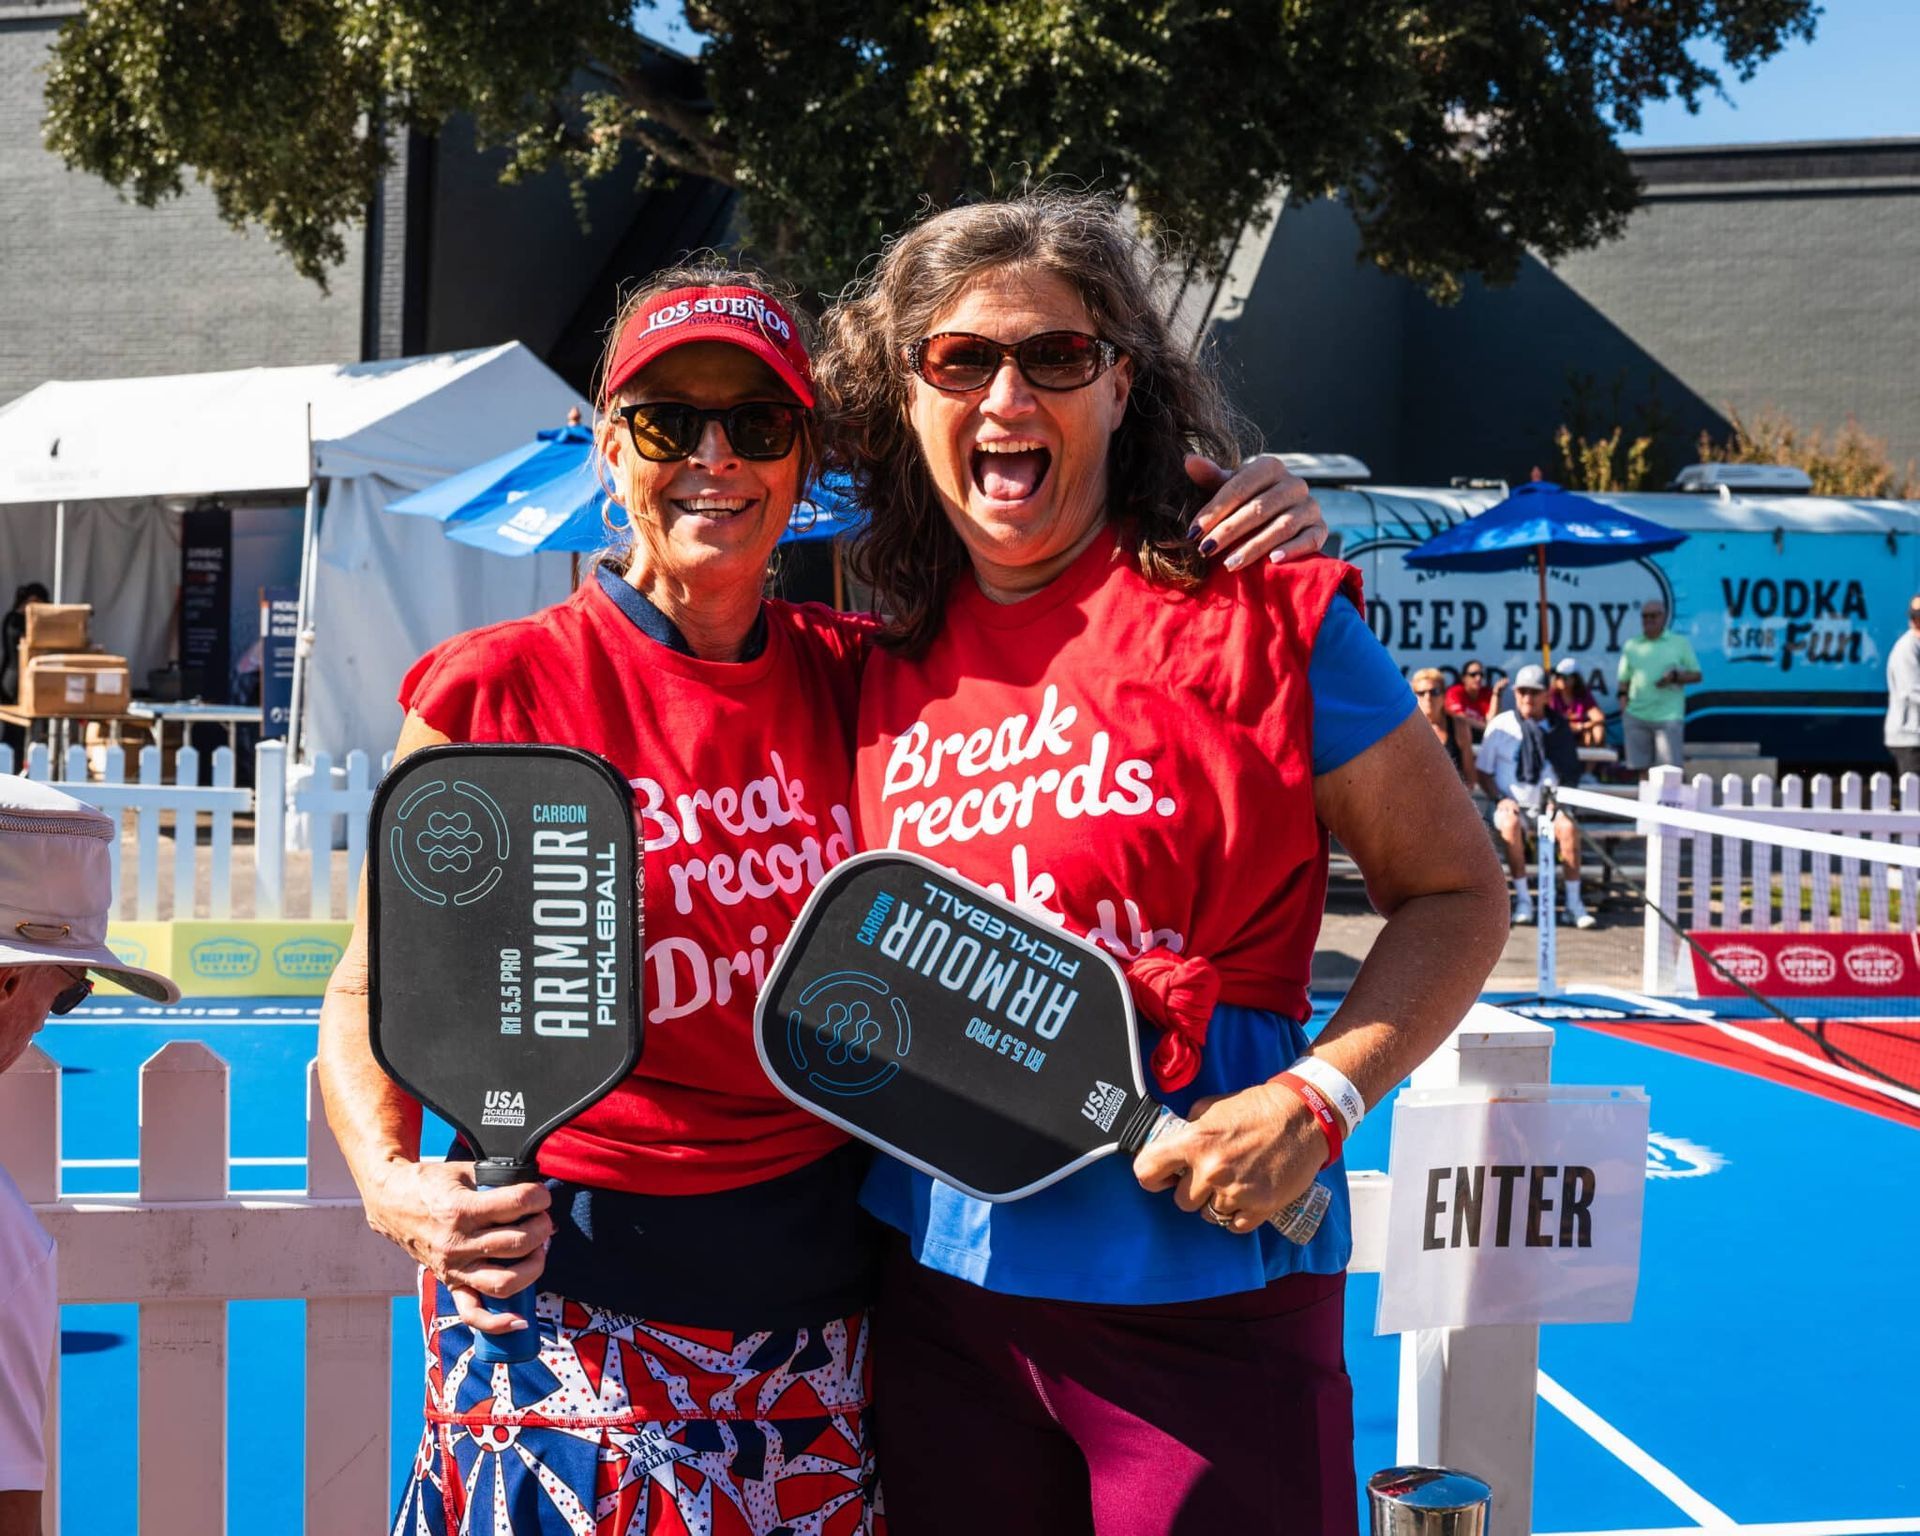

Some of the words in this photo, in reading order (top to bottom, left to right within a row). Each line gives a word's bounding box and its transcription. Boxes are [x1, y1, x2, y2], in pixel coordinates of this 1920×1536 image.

[641, 300, 692, 333] LOS
[694, 295, 791, 341] SUEÑOS
[1721, 576, 1868, 621] VODKA
[1366, 600, 1488, 651] DEEP
[1503, 600, 1630, 653] EDDY
[1727, 628, 1742, 648] IS
[1745, 628, 1777, 648] FOR
[1781, 622, 1863, 672] Fun
[882, 684, 1078, 802] Break
[628, 750, 816, 852] Break
[887, 731, 1176, 850] records.
[532, 804, 587, 823] CARBON
[533, 829, 589, 1037] ARMOUR
[596, 842, 616, 1025] PICKLEBALL
[856, 891, 895, 946] CARBON
[922, 881, 1081, 979] PICKLEBALL
[500, 948, 521, 982] PRO
[880, 902, 1080, 1040] ARMOUR
[500, 985, 521, 1014] 5.5
[965, 1016, 1002, 1050] PRO
[997, 1033, 1027, 1063] 5.5
[1023, 1050, 1048, 1073] R1
[483, 1108, 526, 1117] PICKLEBALL
[484, 1090, 525, 1109] USA
[1081, 1080, 1113, 1121] USA
[1094, 1086, 1119, 1126] PICKLEBALL
[1102, 1090, 1126, 1131] APPROVED
[483, 1116, 525, 1125] APPROVED
[1423, 1165, 1596, 1251] ENTER
[624, 1429, 662, 1454] DINK
[632, 1447, 681, 1477] UNITED
[638, 1443, 662, 1460] WE
